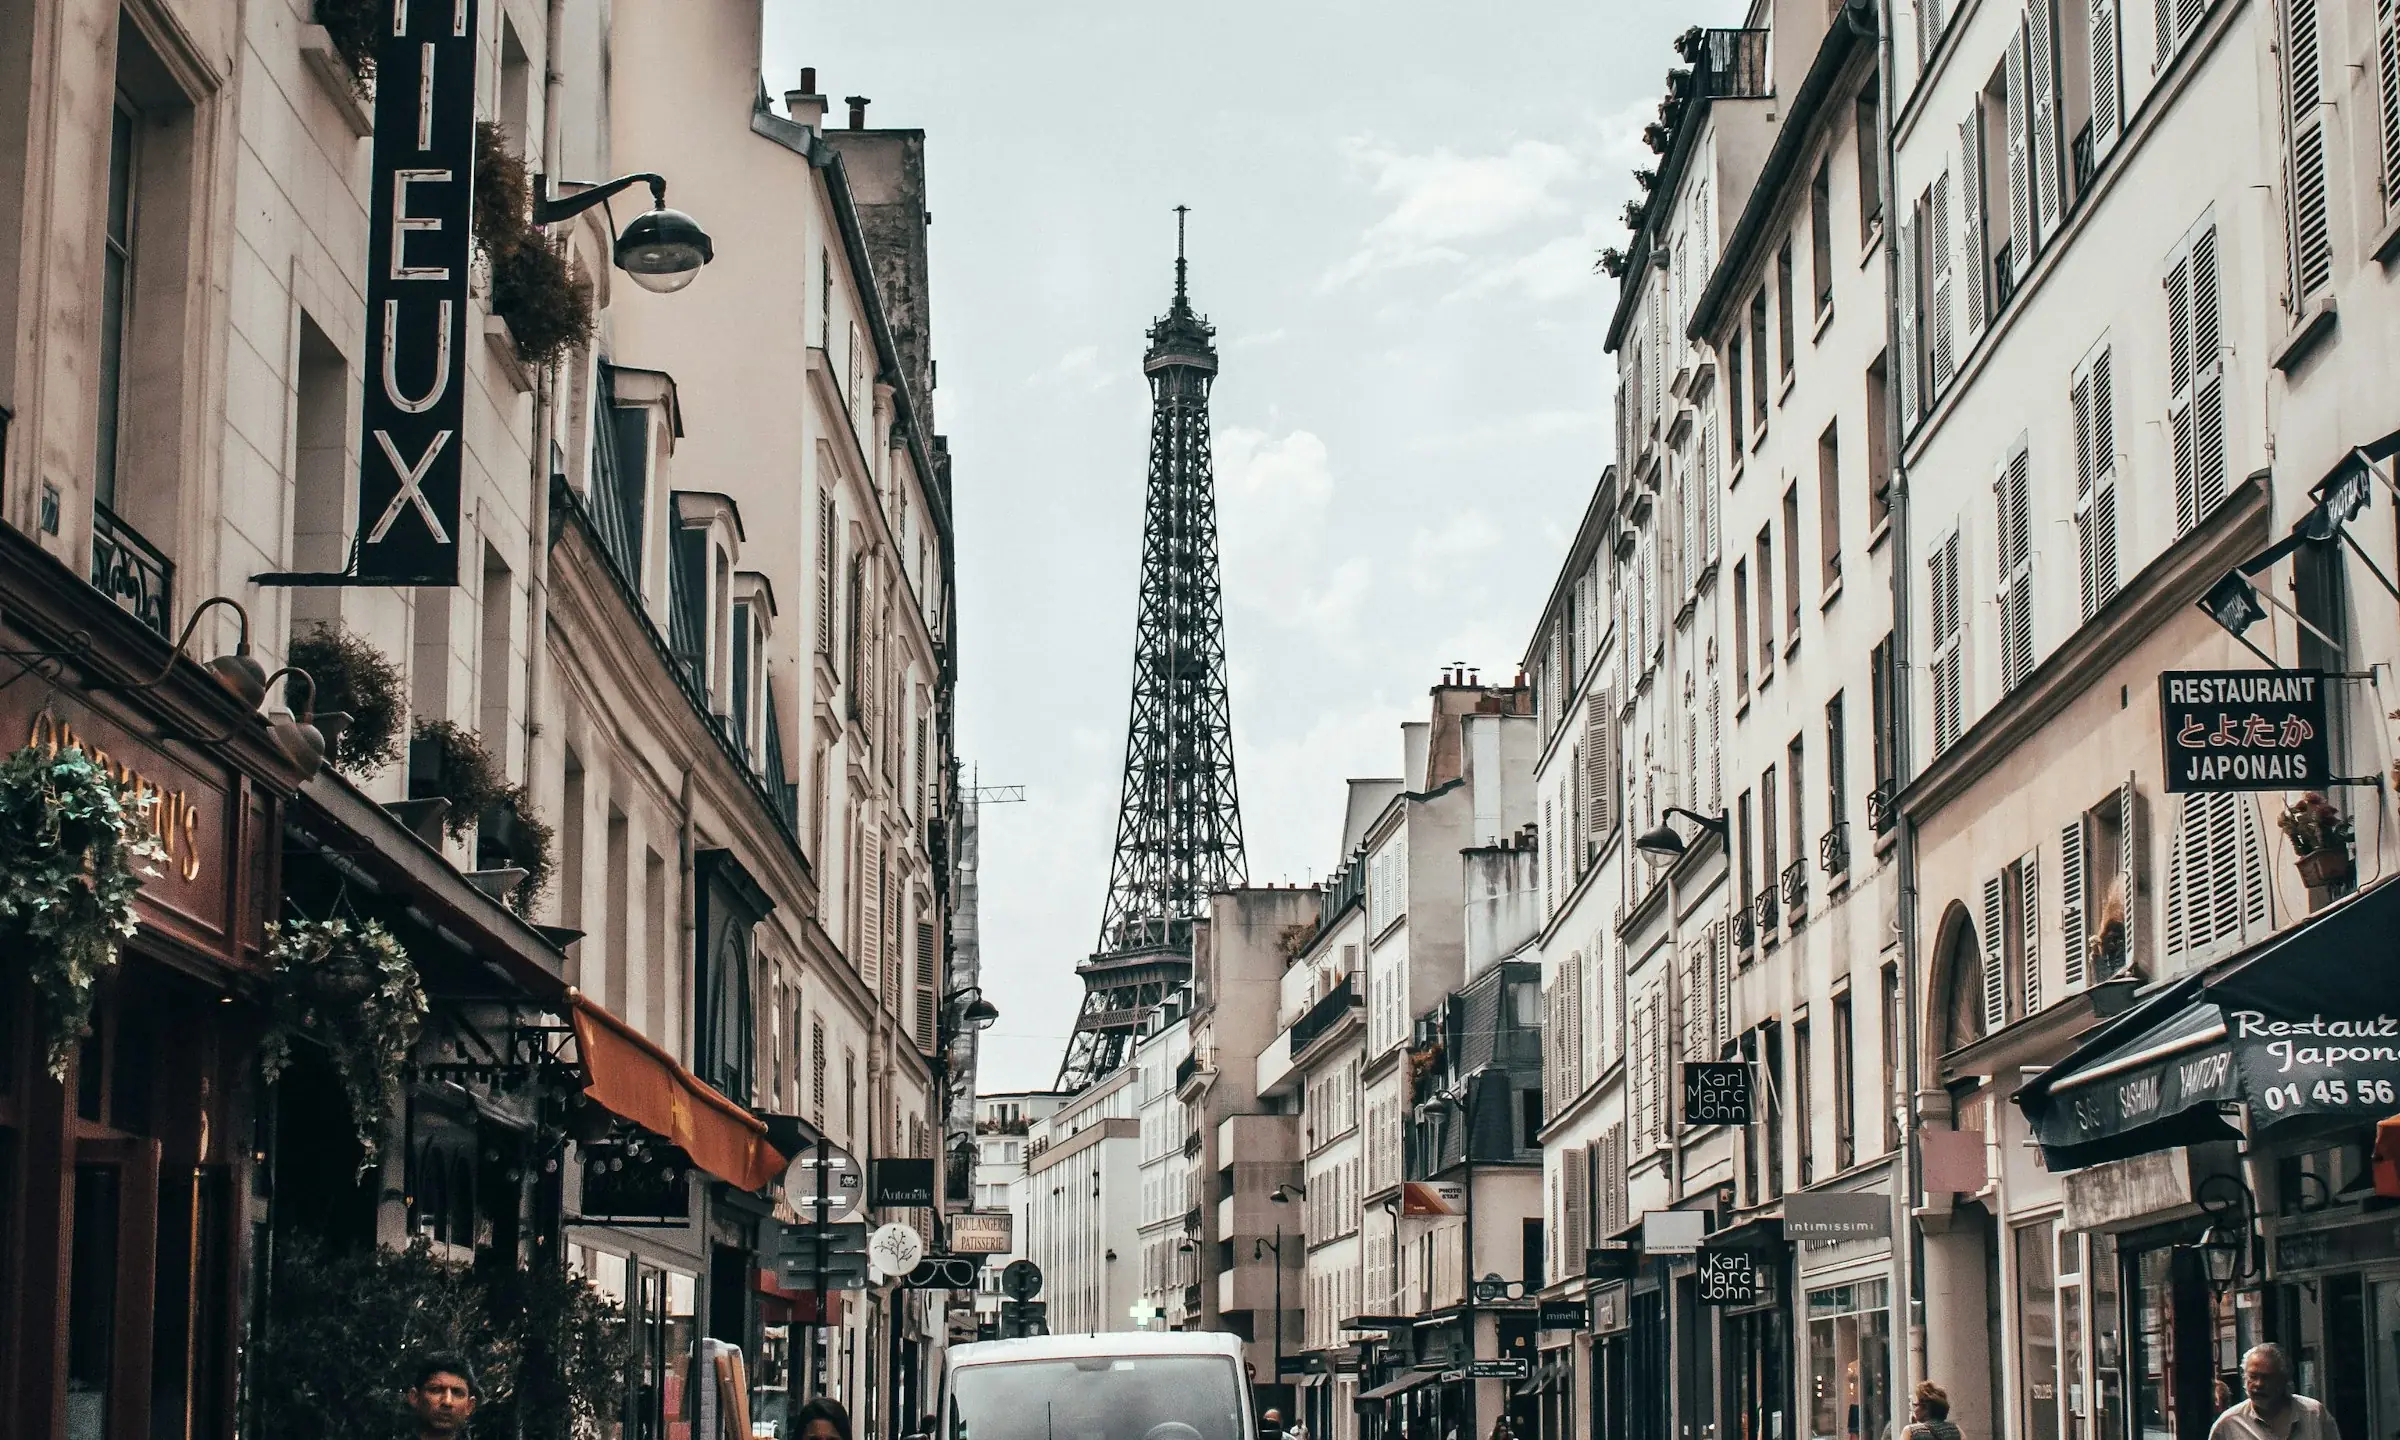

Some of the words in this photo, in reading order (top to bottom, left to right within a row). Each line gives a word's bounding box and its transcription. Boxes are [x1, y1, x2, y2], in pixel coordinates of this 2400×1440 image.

[2170, 677, 2315, 704] RESTAURANT
[2177, 713, 2314, 748] とよたか
[2186, 754, 2307, 781] JAPONAIS
[2267, 1039, 2400, 1073] Japon
[1697, 1068, 1746, 1088] Karl
[2119, 1075, 2159, 1119] SASHIMI
[2180, 1051, 2233, 1099] YAKITORI
[1688, 1085, 1745, 1103] Marc
[2265, 1083, 2302, 1111] 01
[2312, 1080, 2349, 1105] 45
[2357, 1080, 2395, 1105] 56
[1688, 1101, 1745, 1119] John
[955, 1217, 1011, 1233] BOULANGERIE
[1789, 1222, 1875, 1232] intimissimi
[961, 1236, 1004, 1251] PATISSERIE
[1709, 1252, 1752, 1271] Karl
[1700, 1267, 1751, 1285] Marc
[1701, 1282, 1751, 1300] John
[1546, 1309, 1580, 1320] minelli
